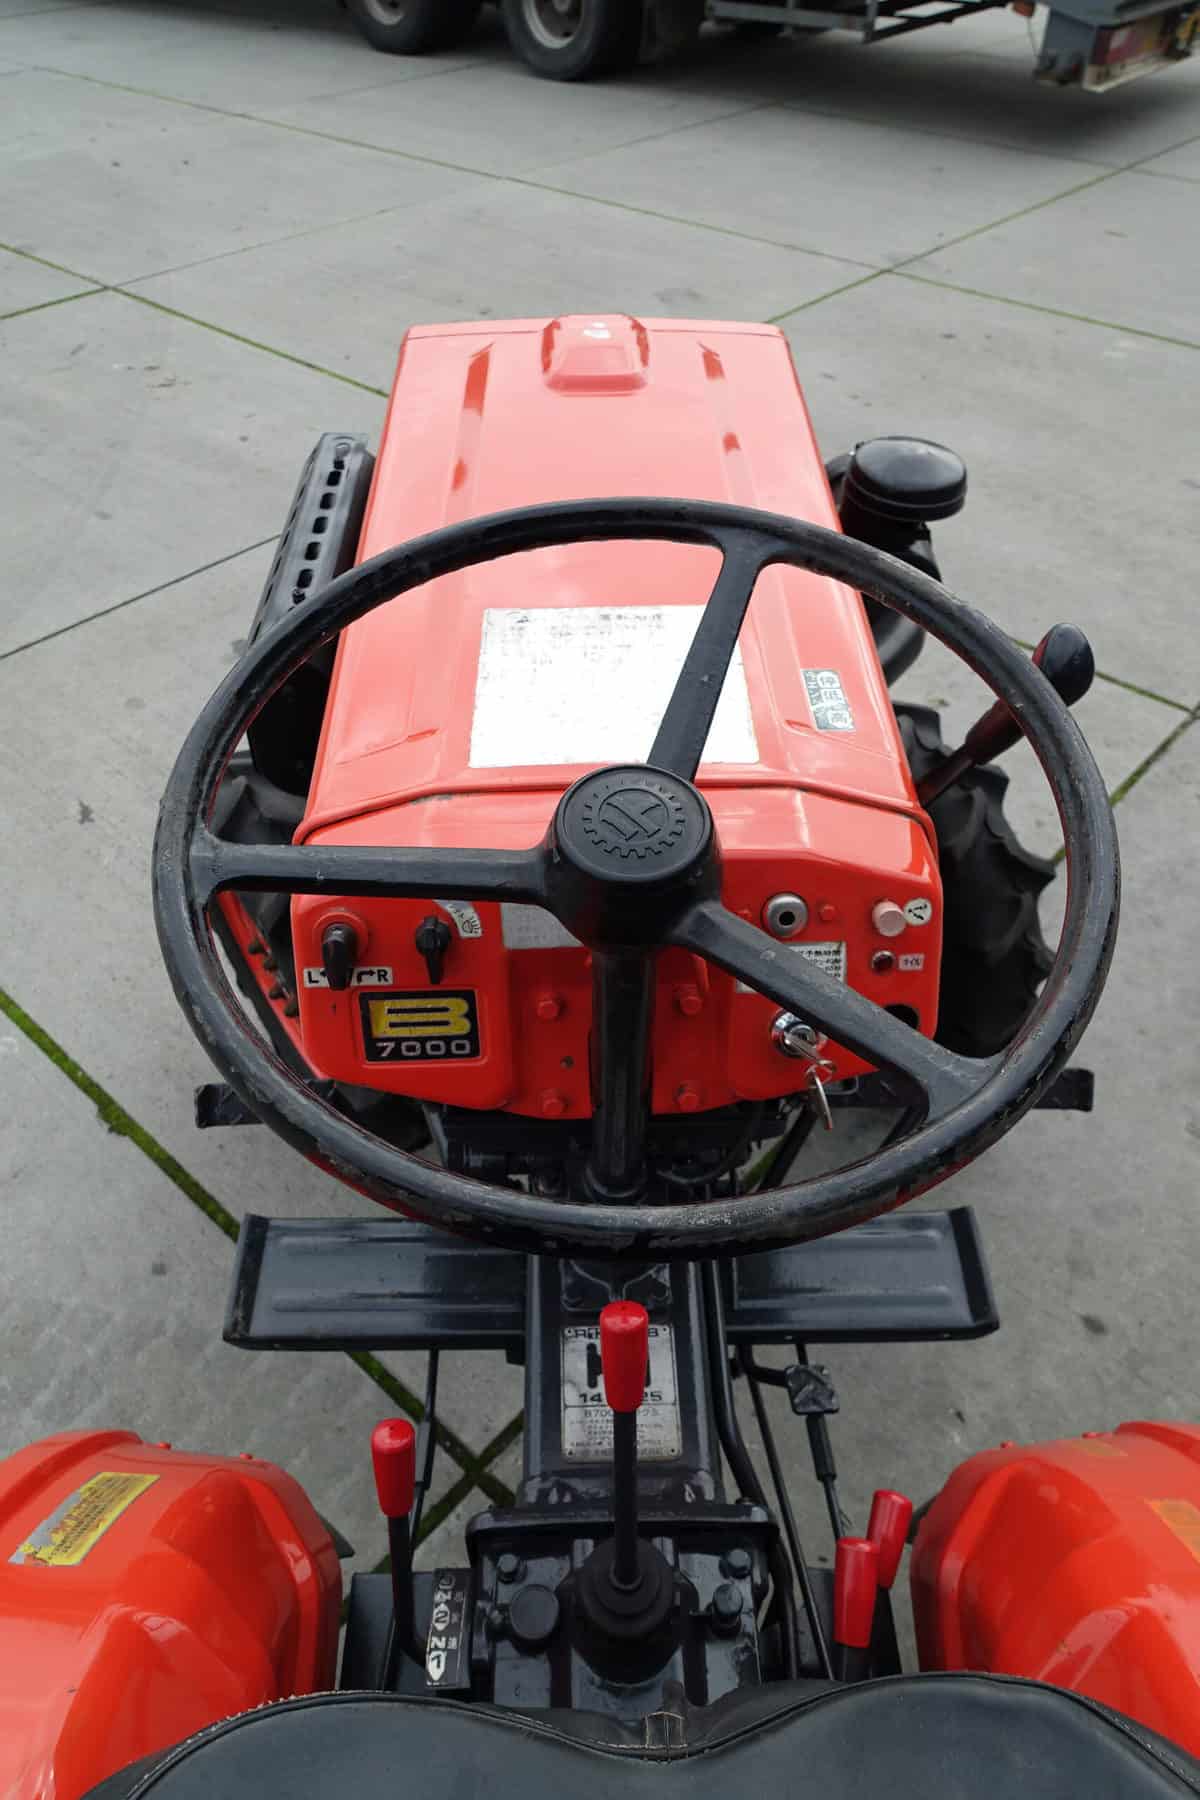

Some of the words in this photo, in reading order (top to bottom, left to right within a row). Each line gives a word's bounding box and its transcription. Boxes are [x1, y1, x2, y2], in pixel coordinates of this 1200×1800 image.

[307, 970, 319, 985] L
[376, 969, 390, 983] R
[375, 1039, 471, 1057] 7000
[578, 1393, 602, 1403] 14
